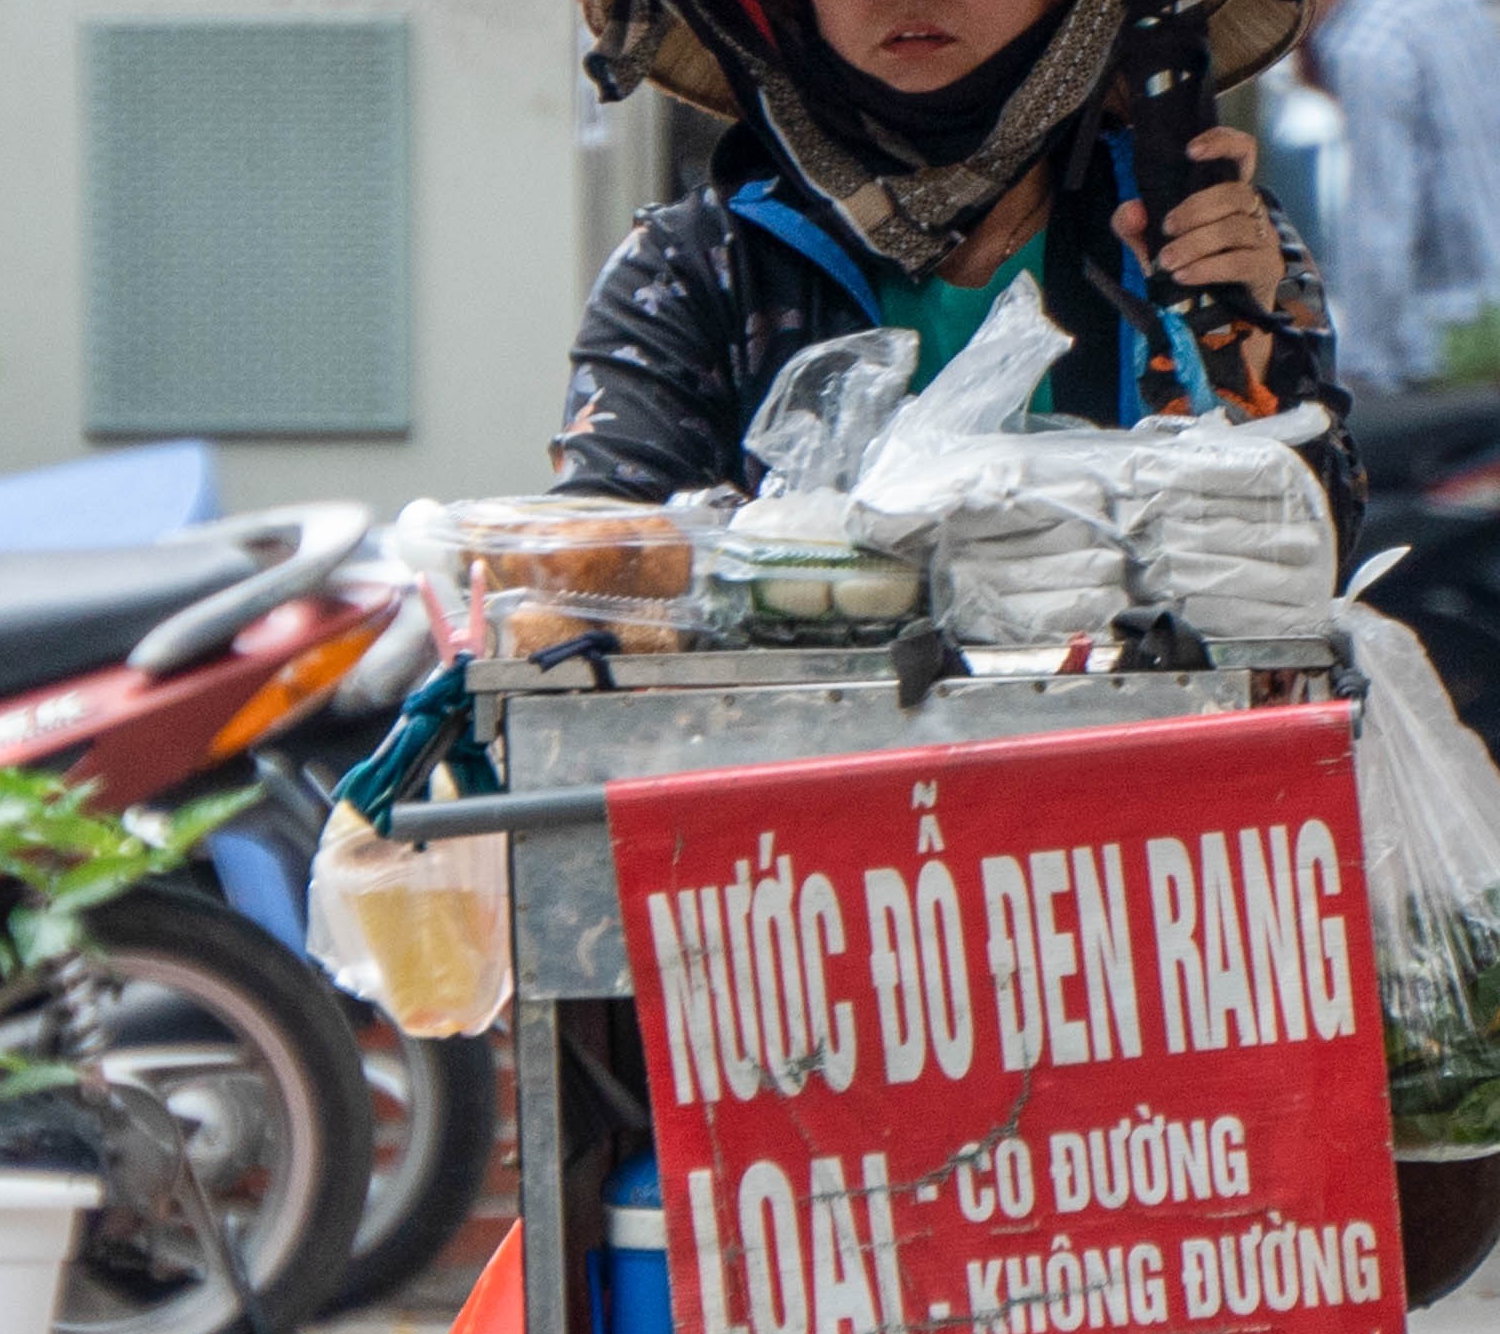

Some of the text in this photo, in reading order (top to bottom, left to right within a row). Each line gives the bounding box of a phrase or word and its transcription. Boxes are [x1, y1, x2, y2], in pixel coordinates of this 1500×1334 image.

[648, 780, 1355, 1105] NƯỚC ĐỖ ĐEN RANG
[1048, 1105, 1249, 1214] ĐƯỜNG
[1179, 1208, 1380, 1322] ĐƯỜNG
